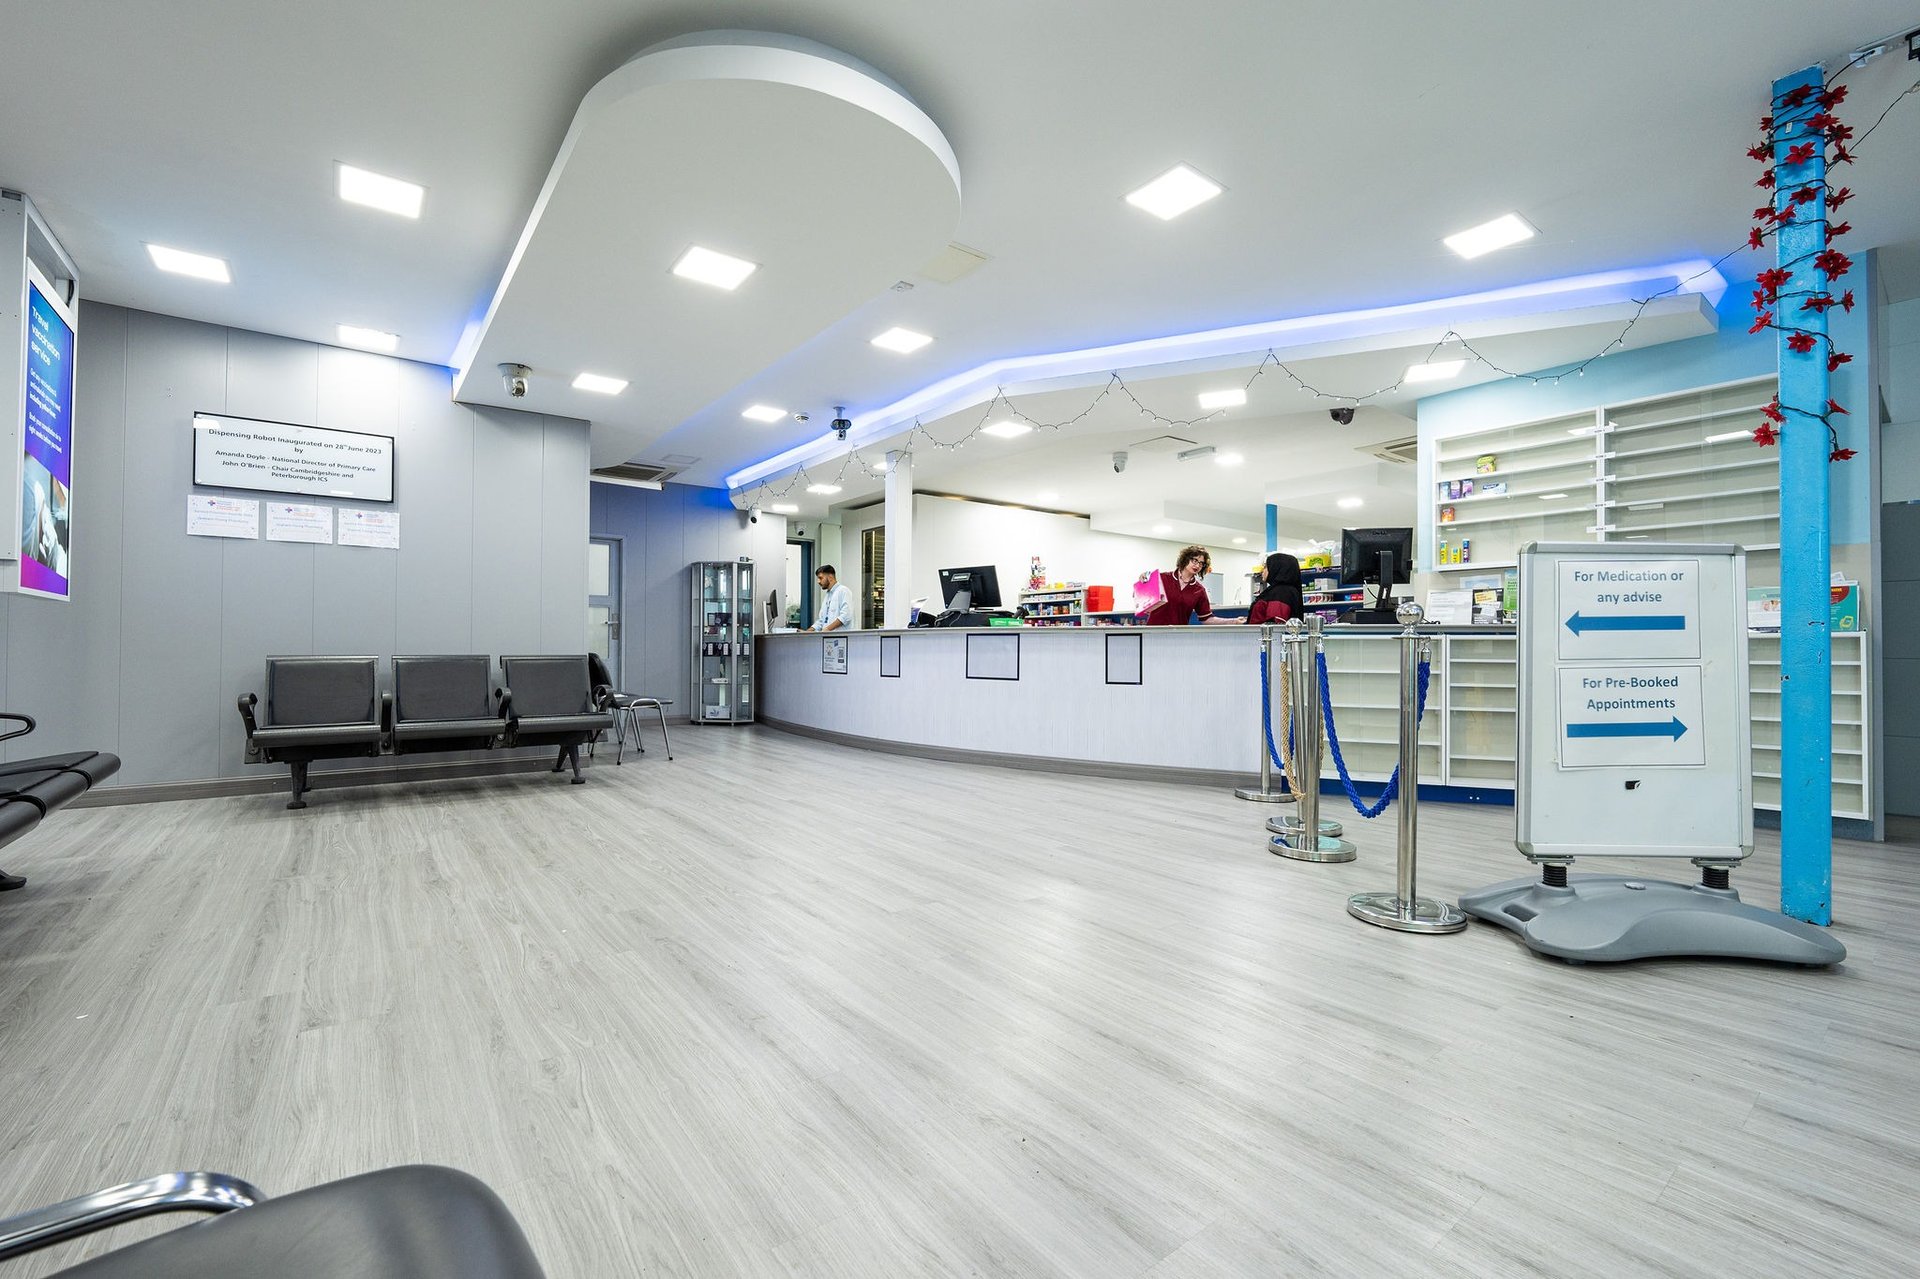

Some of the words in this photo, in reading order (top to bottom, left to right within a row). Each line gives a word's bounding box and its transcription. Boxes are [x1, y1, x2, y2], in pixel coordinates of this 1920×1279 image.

[32, 305, 49, 332] Travel
[32, 324, 60, 360] vaccination
[31, 340, 50, 366] service
[208, 428, 251, 440] Dispensing
[253, 434, 276, 442] Robot
[278, 438, 322, 447] Inaugurated
[215, 450, 244, 458] Amanda
[272, 456, 299, 464] National
[337, 463, 360, 471] Primary
[271, 472, 316, 481] Peterborough
[290, 467, 340, 477] Cambridgeshire
[1574, 571, 1594, 582] For
[1598, 570, 1667, 581] Medication
[1670, 572, 1684, 581] or
[1597, 594, 1619, 604] any
[1623, 592, 1662, 602] advise
[1583, 678, 1602, 688] For
[1606, 676, 1678, 688] Pre-Booked
[1587, 698, 1676, 711] Appointments
